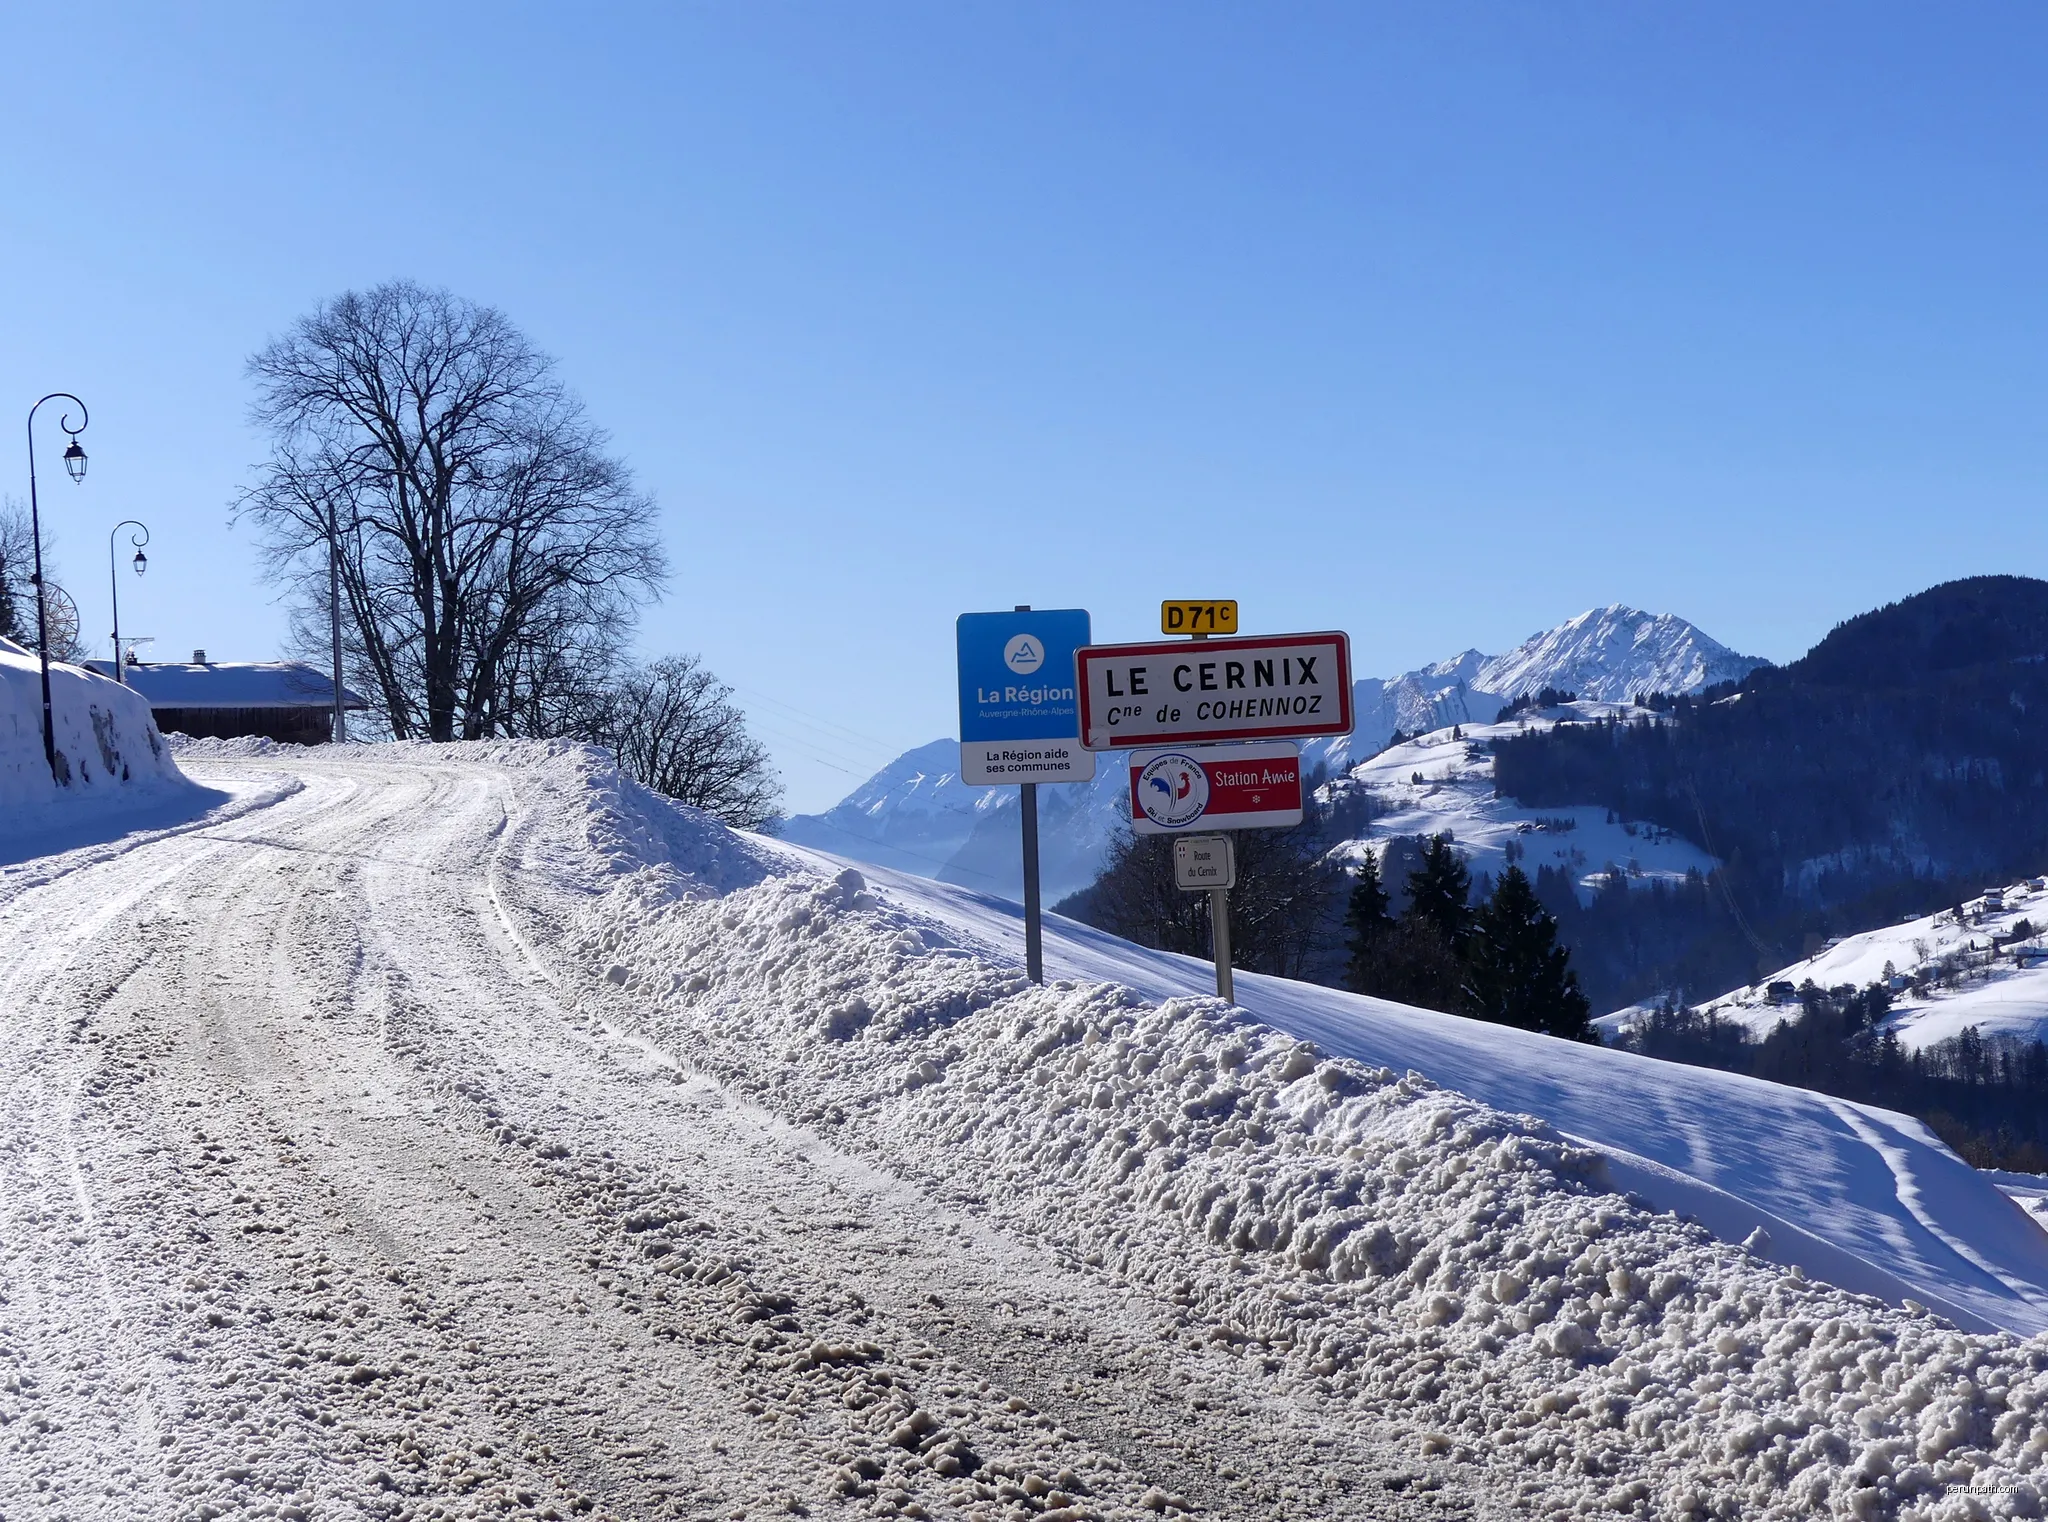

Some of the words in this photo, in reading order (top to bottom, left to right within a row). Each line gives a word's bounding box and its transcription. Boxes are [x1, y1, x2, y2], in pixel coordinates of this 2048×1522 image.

[1106, 667, 1149, 697] LE
[1173, 656, 1319, 693] CERNIX
[977, 687, 1000, 704] La
[1005, 684, 1074, 706] Région
[1156, 704, 1181, 723] de
[1196, 695, 1322, 721] COHENNOZ
[986, 751, 1000, 762] La
[1003, 750, 1042, 762] Région
[1044, 748, 1069, 760] aide
[986, 763, 1005, 774] ses
[1007, 761, 1071, 773] communes
[1142, 759, 1168, 782] Equipes
[1169, 757, 1179, 765] de
[1180, 758, 1202, 780] France
[1215, 770, 1258, 787] Station
[1262, 768, 1295, 785] Amie
[1146, 806, 1158, 818] Ski
[1166, 802, 1204, 825] Snowboard
[1187, 867, 1196, 878] du
